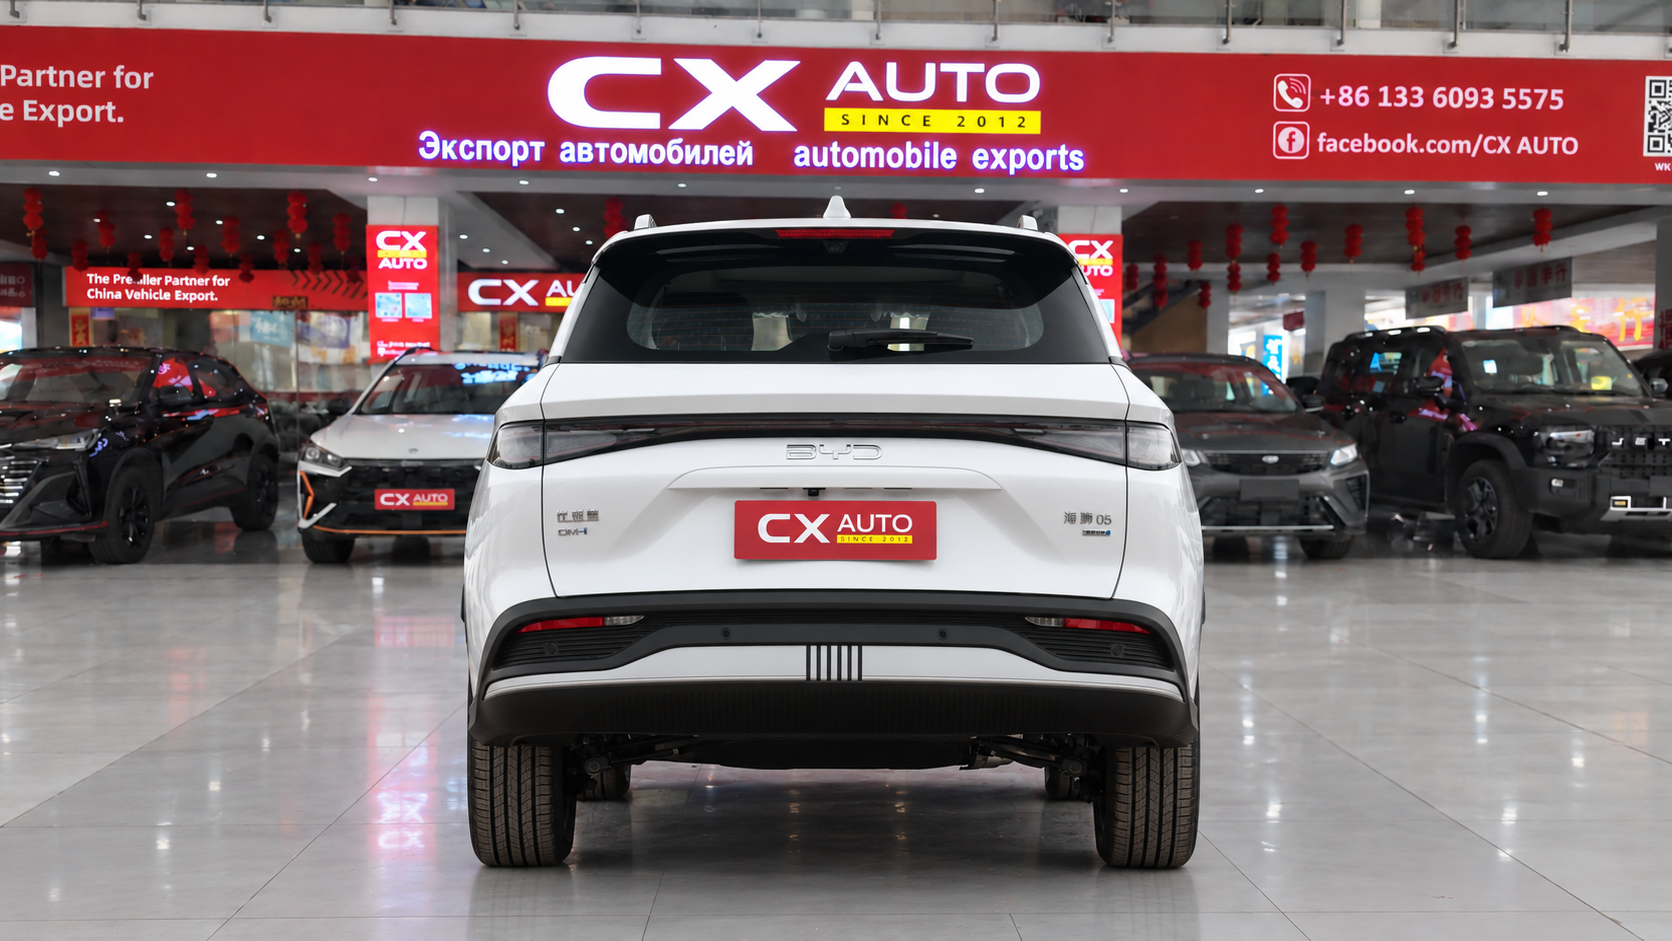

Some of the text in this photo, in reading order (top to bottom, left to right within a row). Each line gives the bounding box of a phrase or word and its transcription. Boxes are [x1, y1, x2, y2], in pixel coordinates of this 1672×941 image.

[0, 64, 154, 89] Partner for
[825, 61, 1041, 103] AUTO
[547, 56, 801, 132] CX
[1319, 85, 1564, 110] +86 133 6093 5575
[23, 100, 124, 128] Export.
[841, 114, 1026, 128] SINCE 2012
[418, 130, 754, 167] Экспорт автомобилей
[1317, 132, 1579, 157] facebook.com/CX AUTO
[794, 141, 1085, 175] automobile exports
[1654, 162, 1672, 172] WK
[375, 230, 427, 251] CX
[1067, 239, 1113, 260] CX
[378, 257, 428, 270] AUTO
[1083, 265, 1113, 277] UTO
[86, 273, 110, 285] The
[164, 275, 210, 287] Partner
[212, 274, 230, 287] for
[86, 287, 218, 304] China Vehicle Export.
[467, 278, 539, 306] CX
[786, 444, 883, 460] BYD
[380, 493, 448, 506] CX AUTO
[757, 513, 831, 544] CX
[836, 513, 913, 533] AUTO
[1095, 514, 1112, 526] 05
